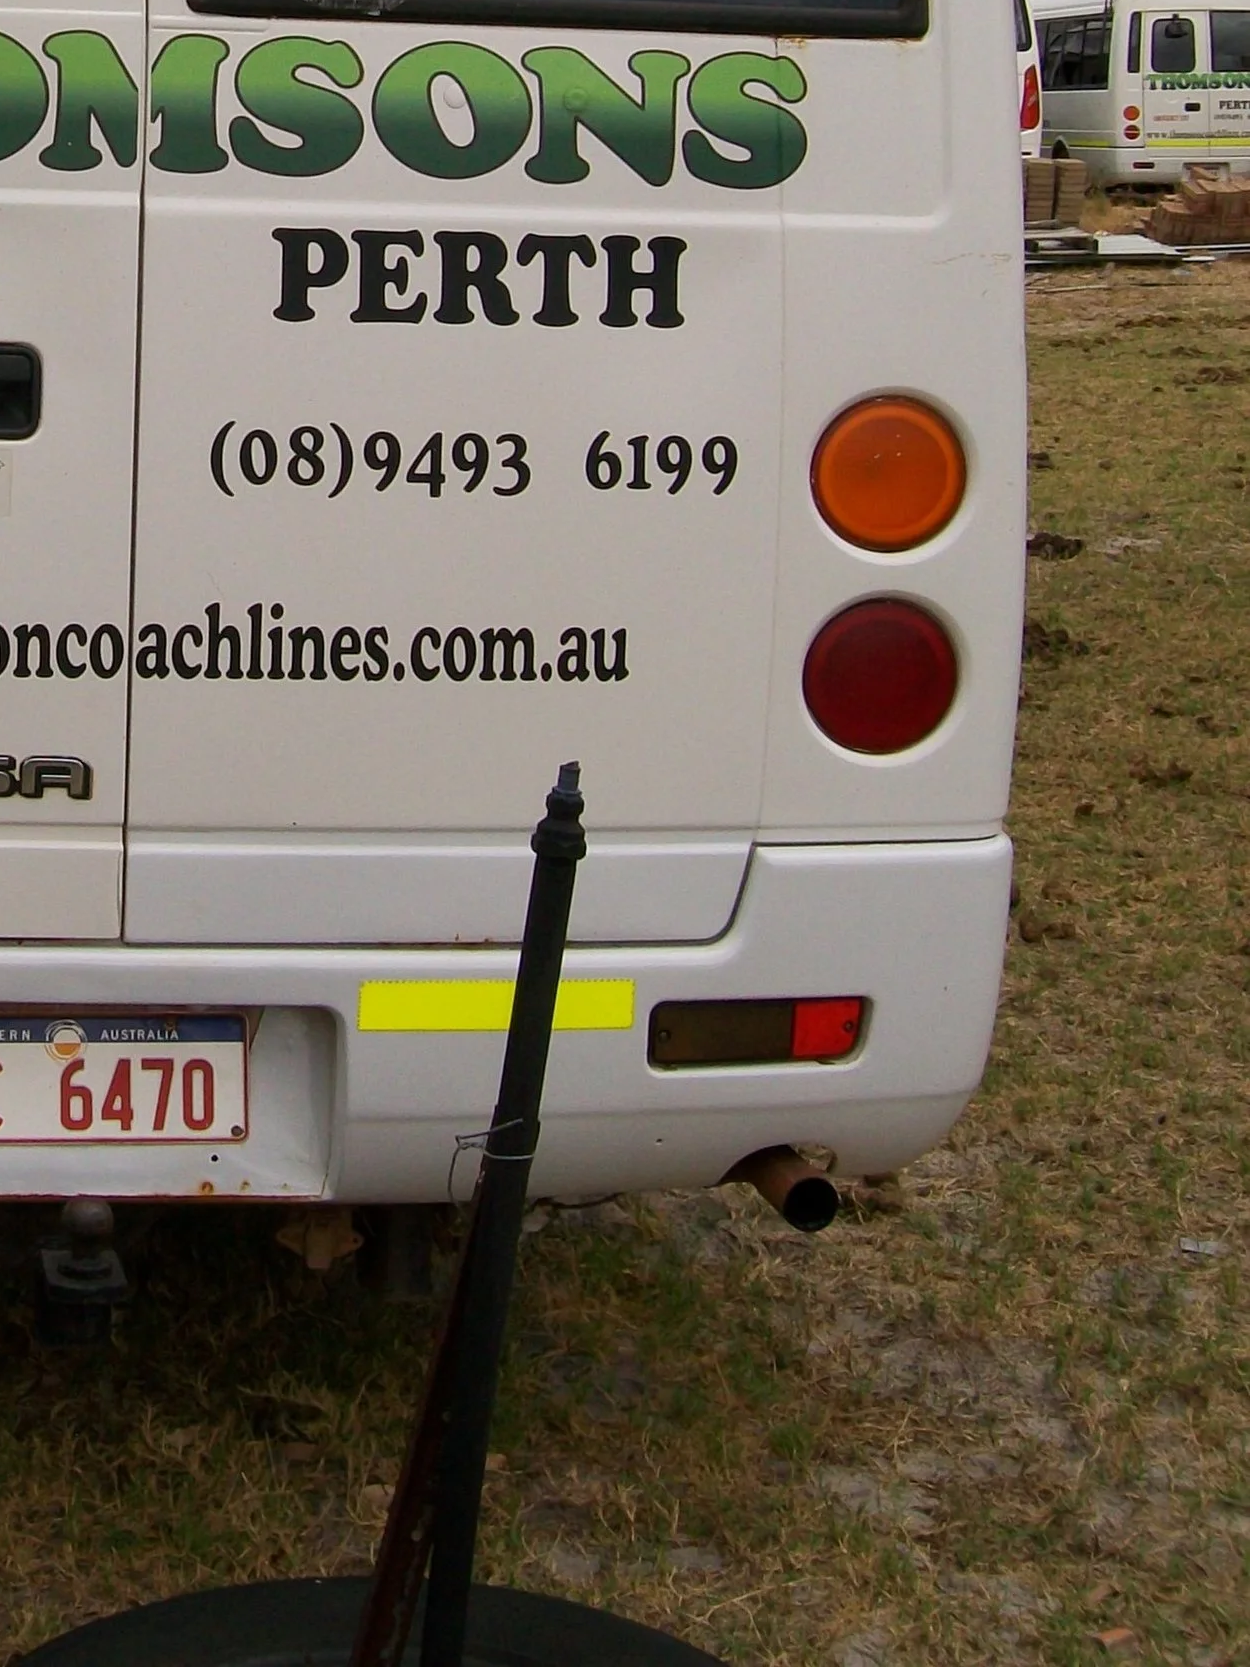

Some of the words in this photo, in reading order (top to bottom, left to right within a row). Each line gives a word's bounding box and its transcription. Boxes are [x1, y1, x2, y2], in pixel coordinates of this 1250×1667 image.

[271, 227, 688, 329] PERTH
[210, 420, 533, 500] (08)9493
[584, 430, 740, 497] 6199
[100, 1029, 180, 1042] AUSTRALIA
[59, 1057, 215, 1132] 6470
